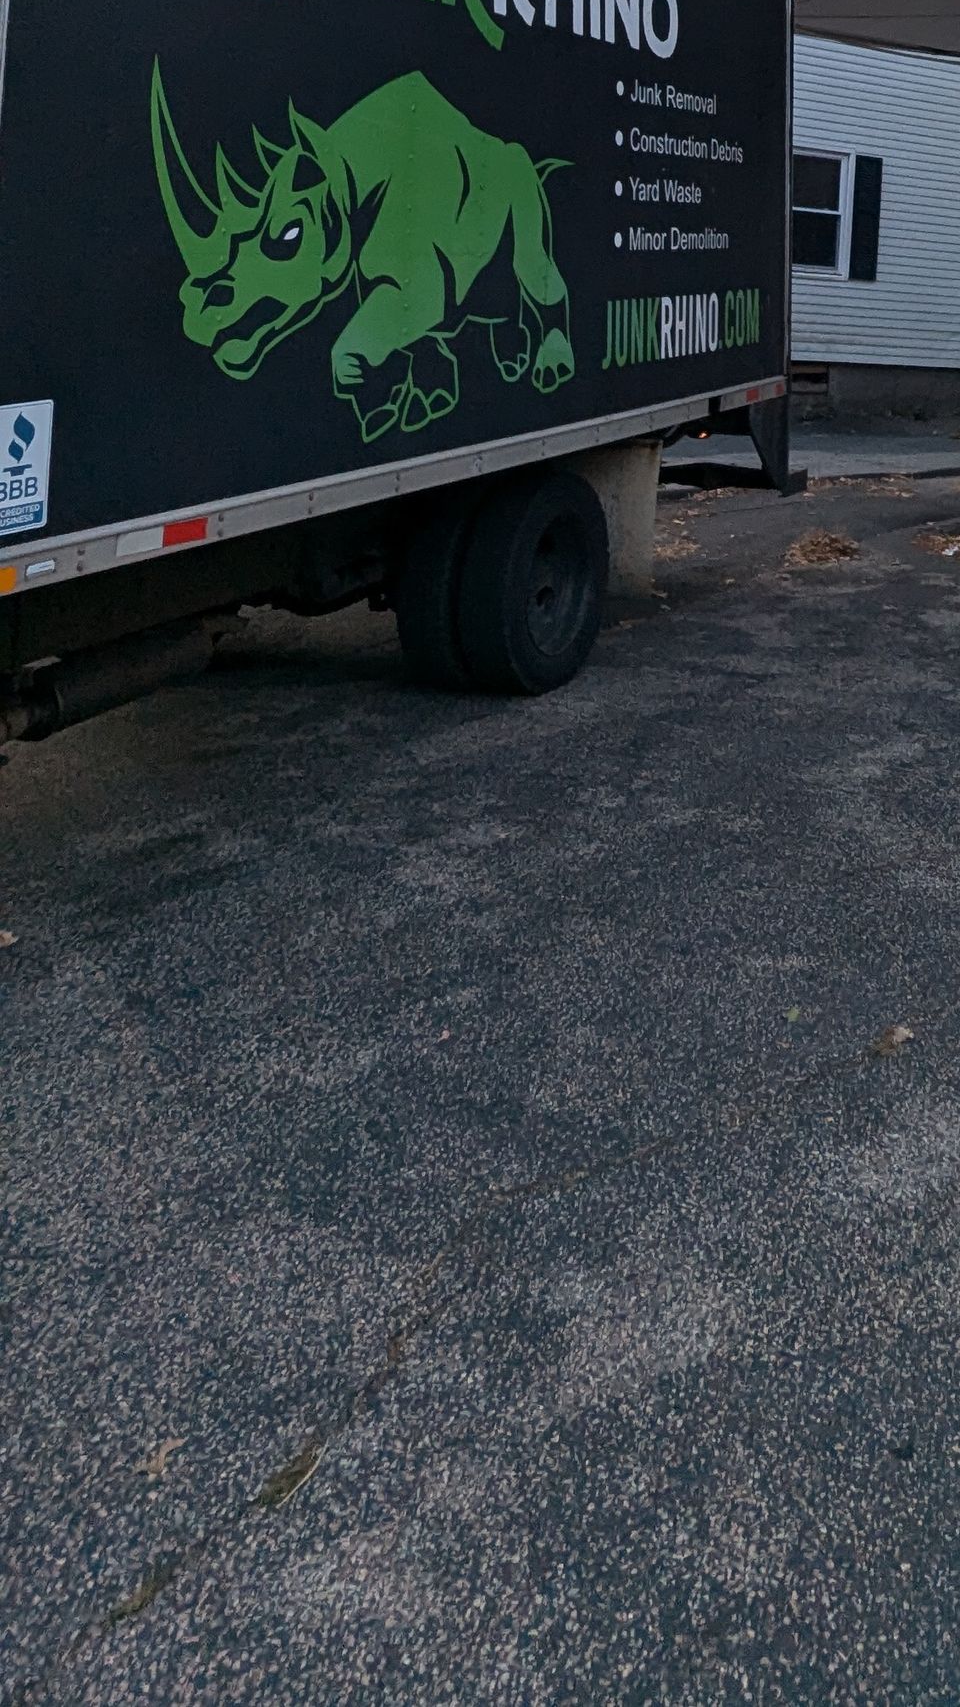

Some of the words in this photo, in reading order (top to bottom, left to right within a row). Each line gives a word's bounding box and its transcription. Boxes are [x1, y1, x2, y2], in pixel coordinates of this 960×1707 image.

[630, 79, 662, 107] Junk
[666, 85, 717, 115] Removal
[630, 127, 708, 159] Construction
[711, 138, 743, 164] Debris
[629, 176, 660, 202] Yard
[664, 179, 702, 204] Waste
[629, 226, 667, 251] Minor
[670, 226, 729, 251] Demolition
[602, 288, 759, 370] JUNKRHINO.COM
[0, 503, 40, 518] CREDITED
[0, 513, 34, 527] USINESS
